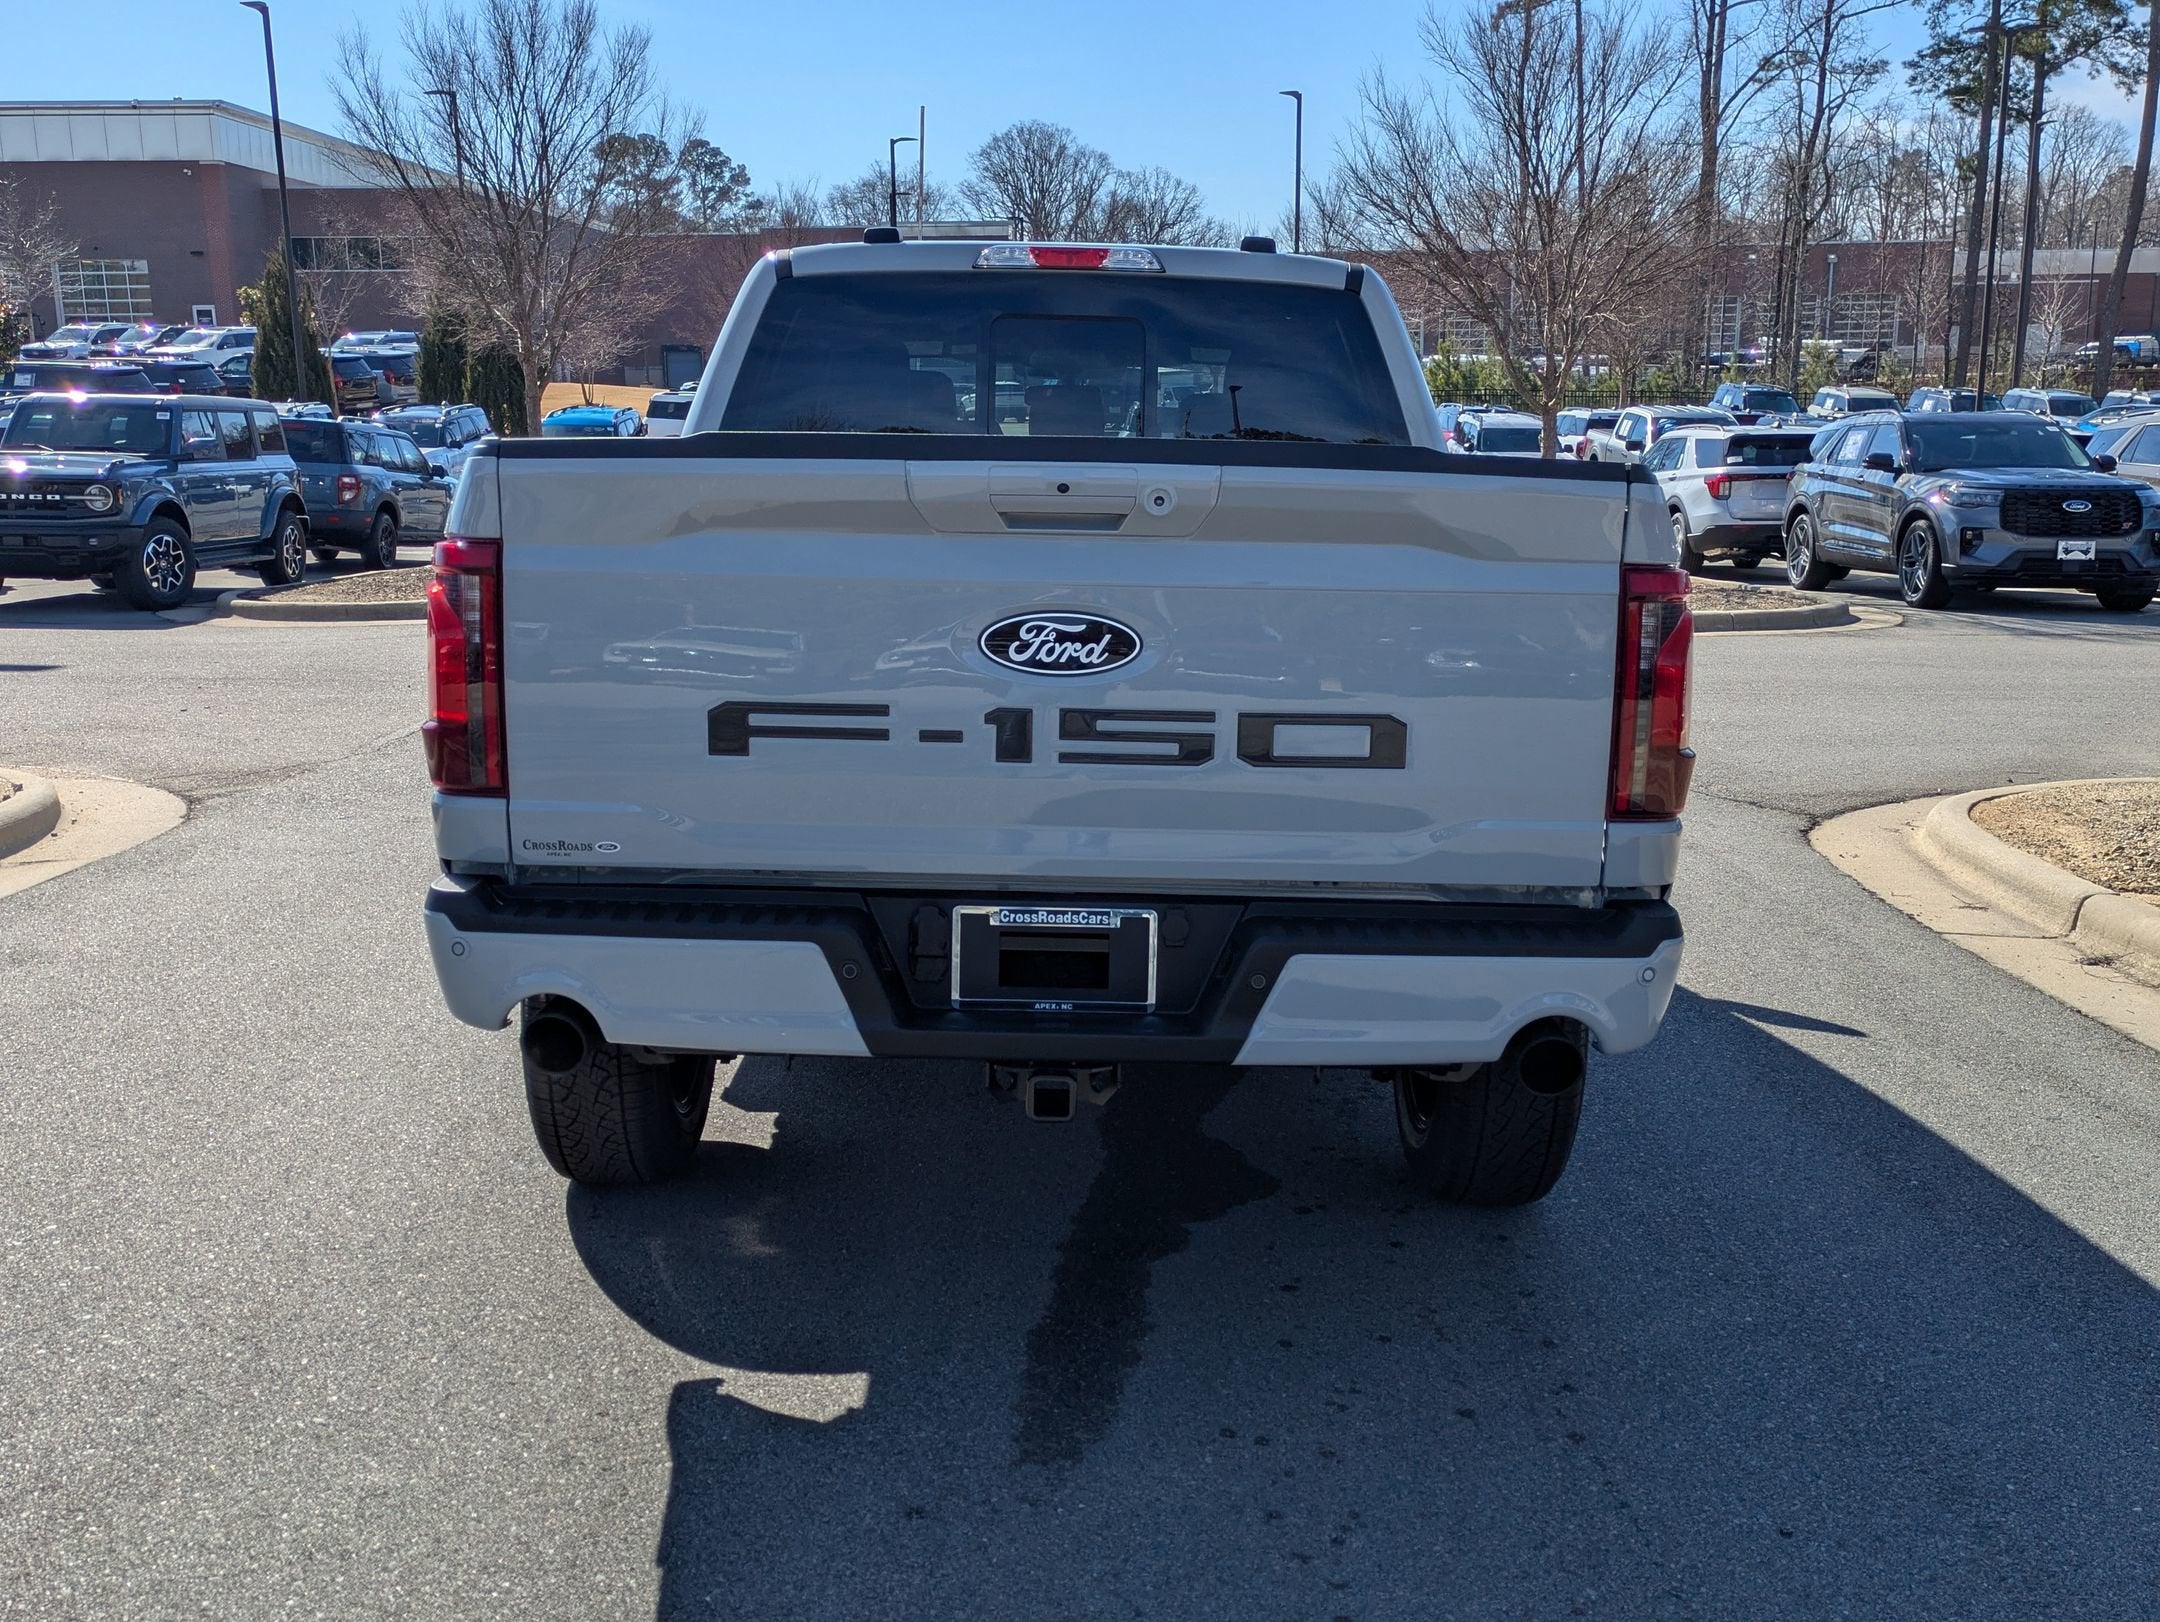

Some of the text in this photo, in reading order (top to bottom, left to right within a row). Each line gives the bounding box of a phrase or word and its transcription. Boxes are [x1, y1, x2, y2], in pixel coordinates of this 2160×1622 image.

[1009, 621, 1112, 664] Ford
[708, 701, 1407, 769] F-150
[1000, 911, 1109, 925] CrossRoadsCars
